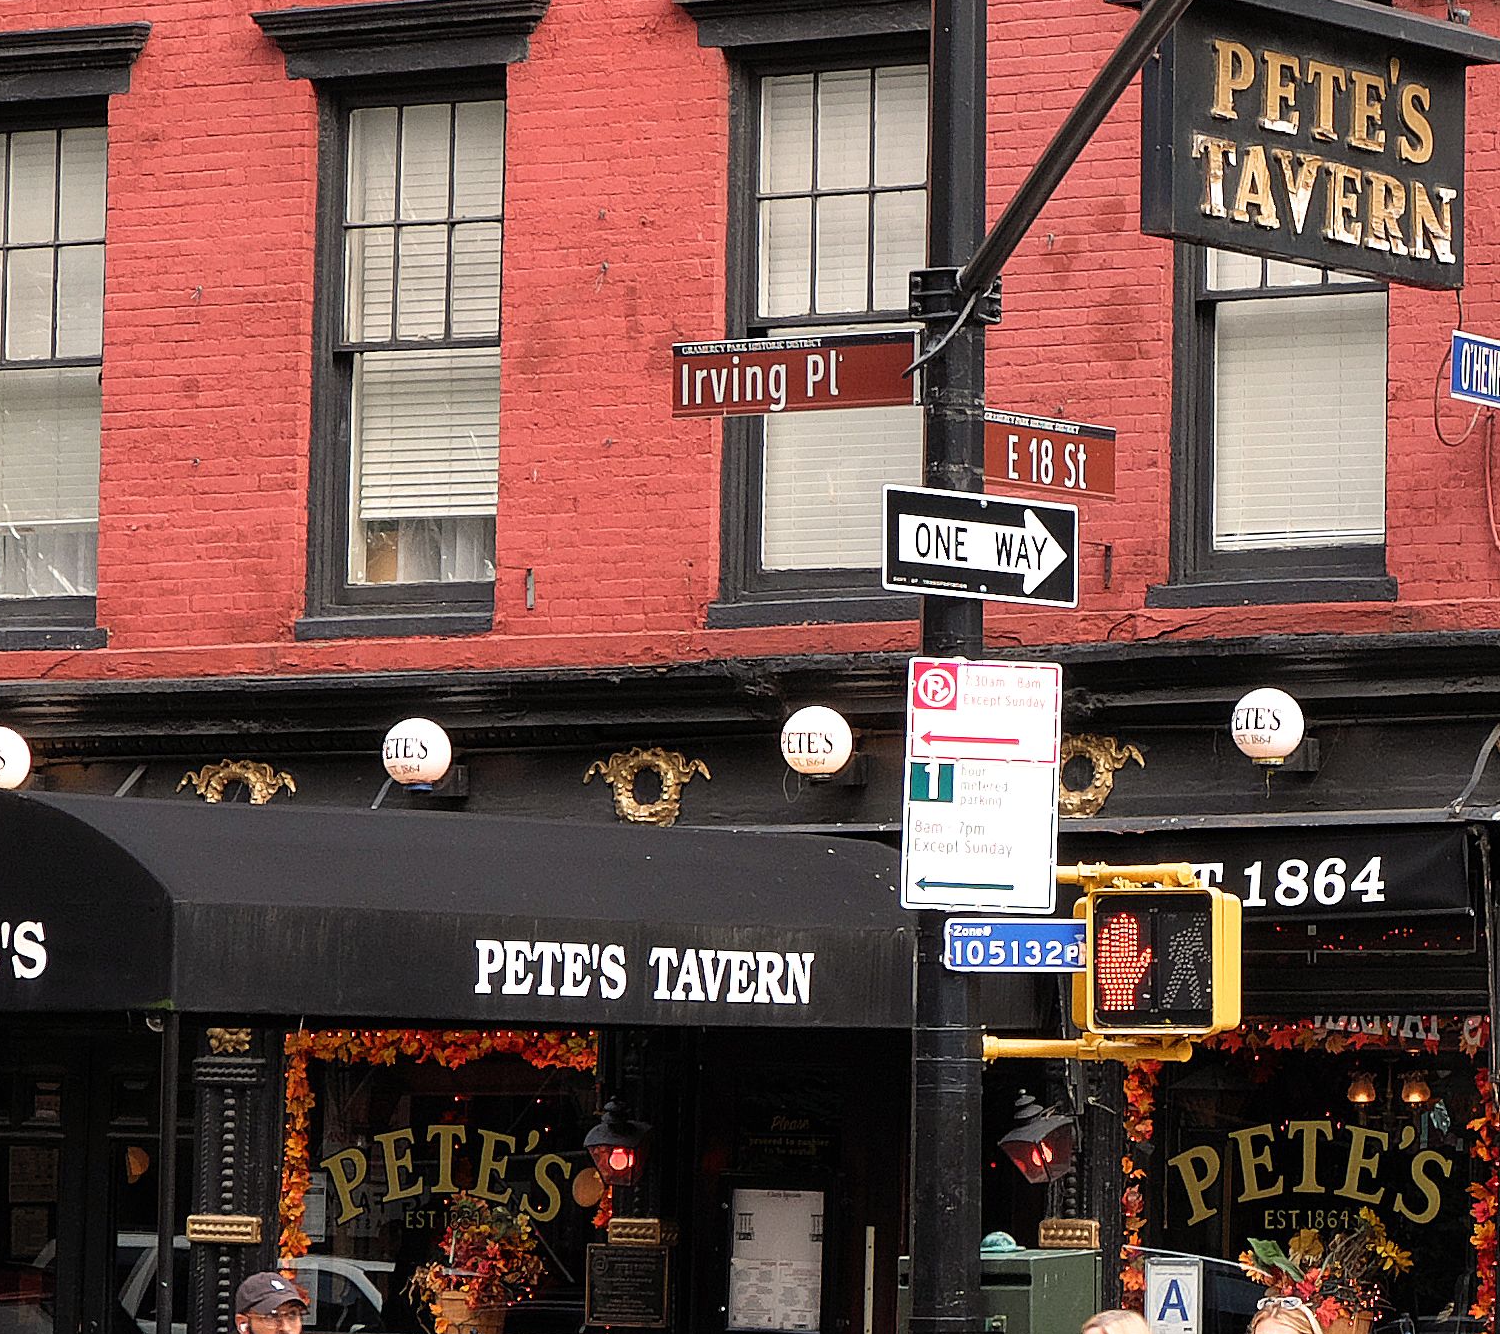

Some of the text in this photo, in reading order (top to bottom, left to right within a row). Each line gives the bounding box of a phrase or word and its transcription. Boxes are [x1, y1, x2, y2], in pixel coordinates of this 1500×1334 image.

[1210, 37, 1434, 164] PETE'S
[1192, 133, 1457, 264] TAVERN
[681, 338, 822, 355] GRAMERCY PARK HISTORIC DISTRICT
[681, 350, 840, 412] Irving Pl
[1015, 416, 1030, 427] PARK
[1055, 423, 1080, 435] DISTRICT
[1008, 434, 1087, 489] E 18 St
[915, 522, 1047, 570] ONE WAY
[1017, 676, 1042, 689] 8am
[963, 693, 1046, 709] Except Sunday
[1235, 707, 1281, 731] ETE'S
[385, 737, 428, 759] ETE'S
[924, 762, 940, 800] 1
[961, 764, 986, 777] hour
[960, 781, 1008, 792] metered
[960, 795, 1002, 808] parking
[914, 819, 942, 834] 8am
[960, 821, 985, 837] 7pm
[914, 838, 1013, 858] Except Sunday
[1242, 856, 1386, 907] 1864
[953, 925, 992, 937] Zone#
[953, 940, 1063, 966] 105132
[474, 938, 815, 1005] PETE'S TAVERN
[320, 1125, 572, 1225] PETE'S
[1168, 1120, 1453, 1225] PETE'S
[1307, 1209, 1350, 1229] 1864
[1157, 1279, 1189, 1321] A
